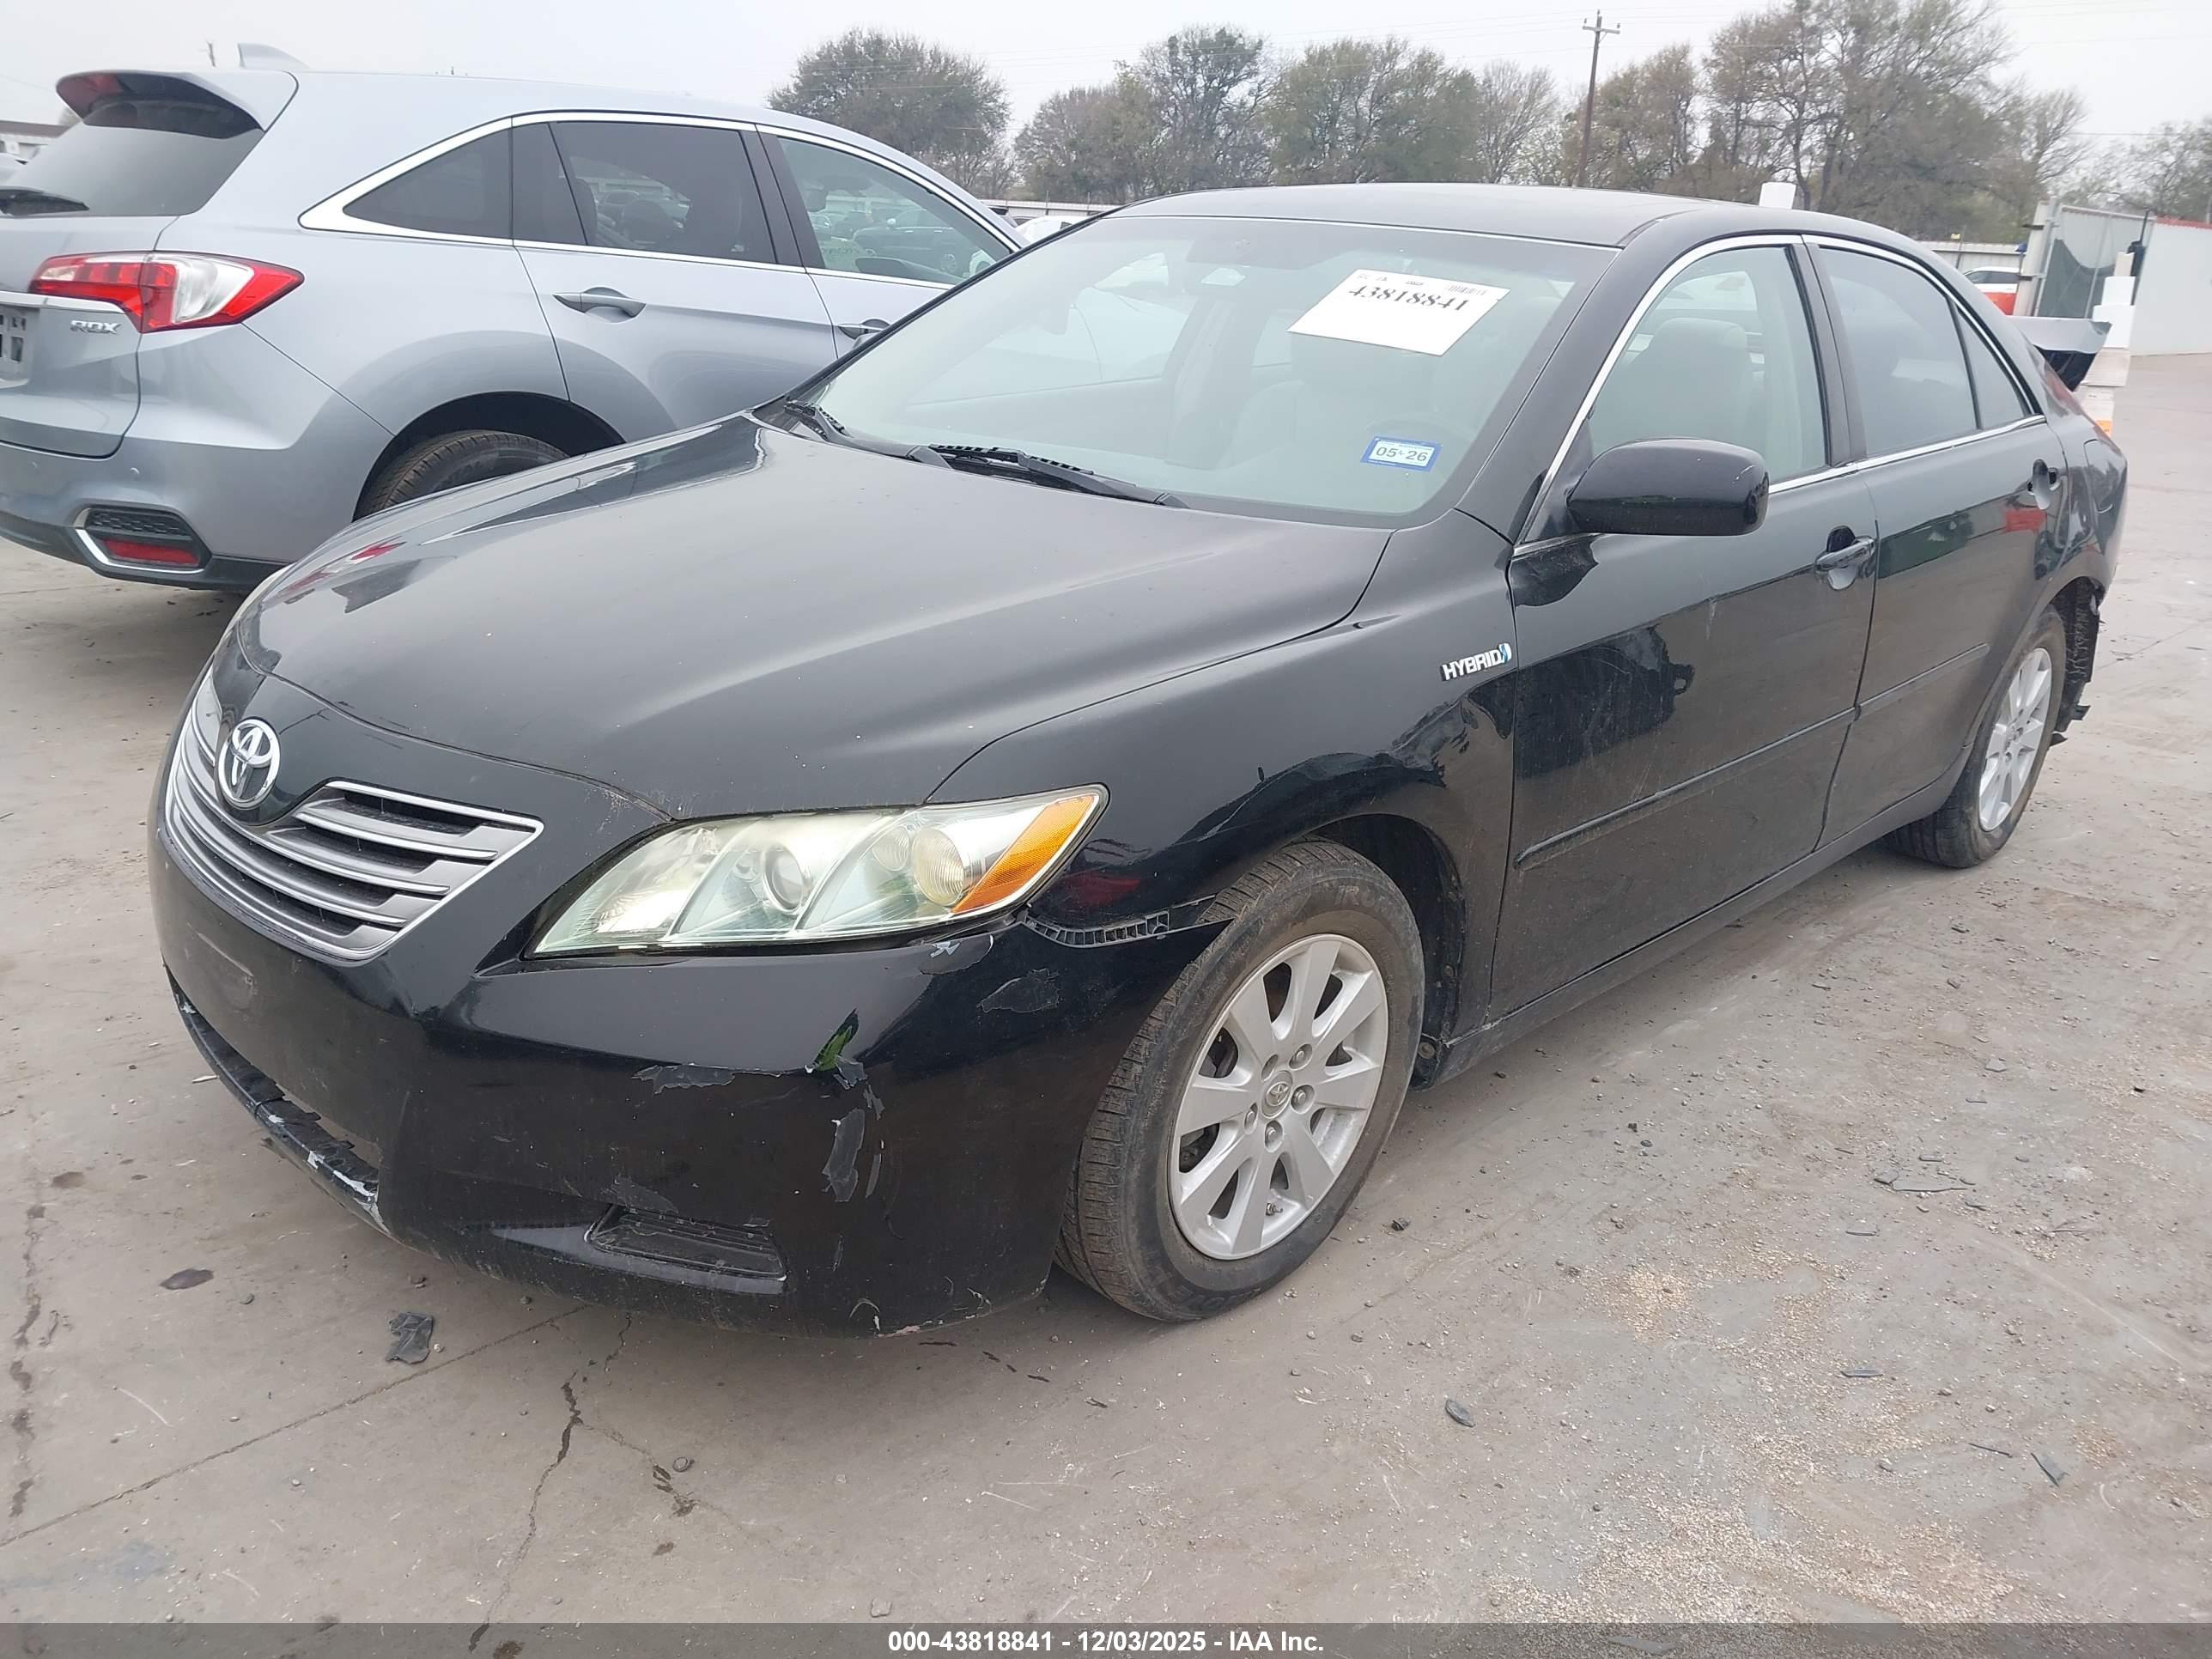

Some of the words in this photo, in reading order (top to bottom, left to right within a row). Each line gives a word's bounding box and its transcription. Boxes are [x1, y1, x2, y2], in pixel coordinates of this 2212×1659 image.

[1349, 285, 1469, 311] 43818841
[70, 319, 122, 335] RDX
[1442, 649, 1505, 681] HYBRID
